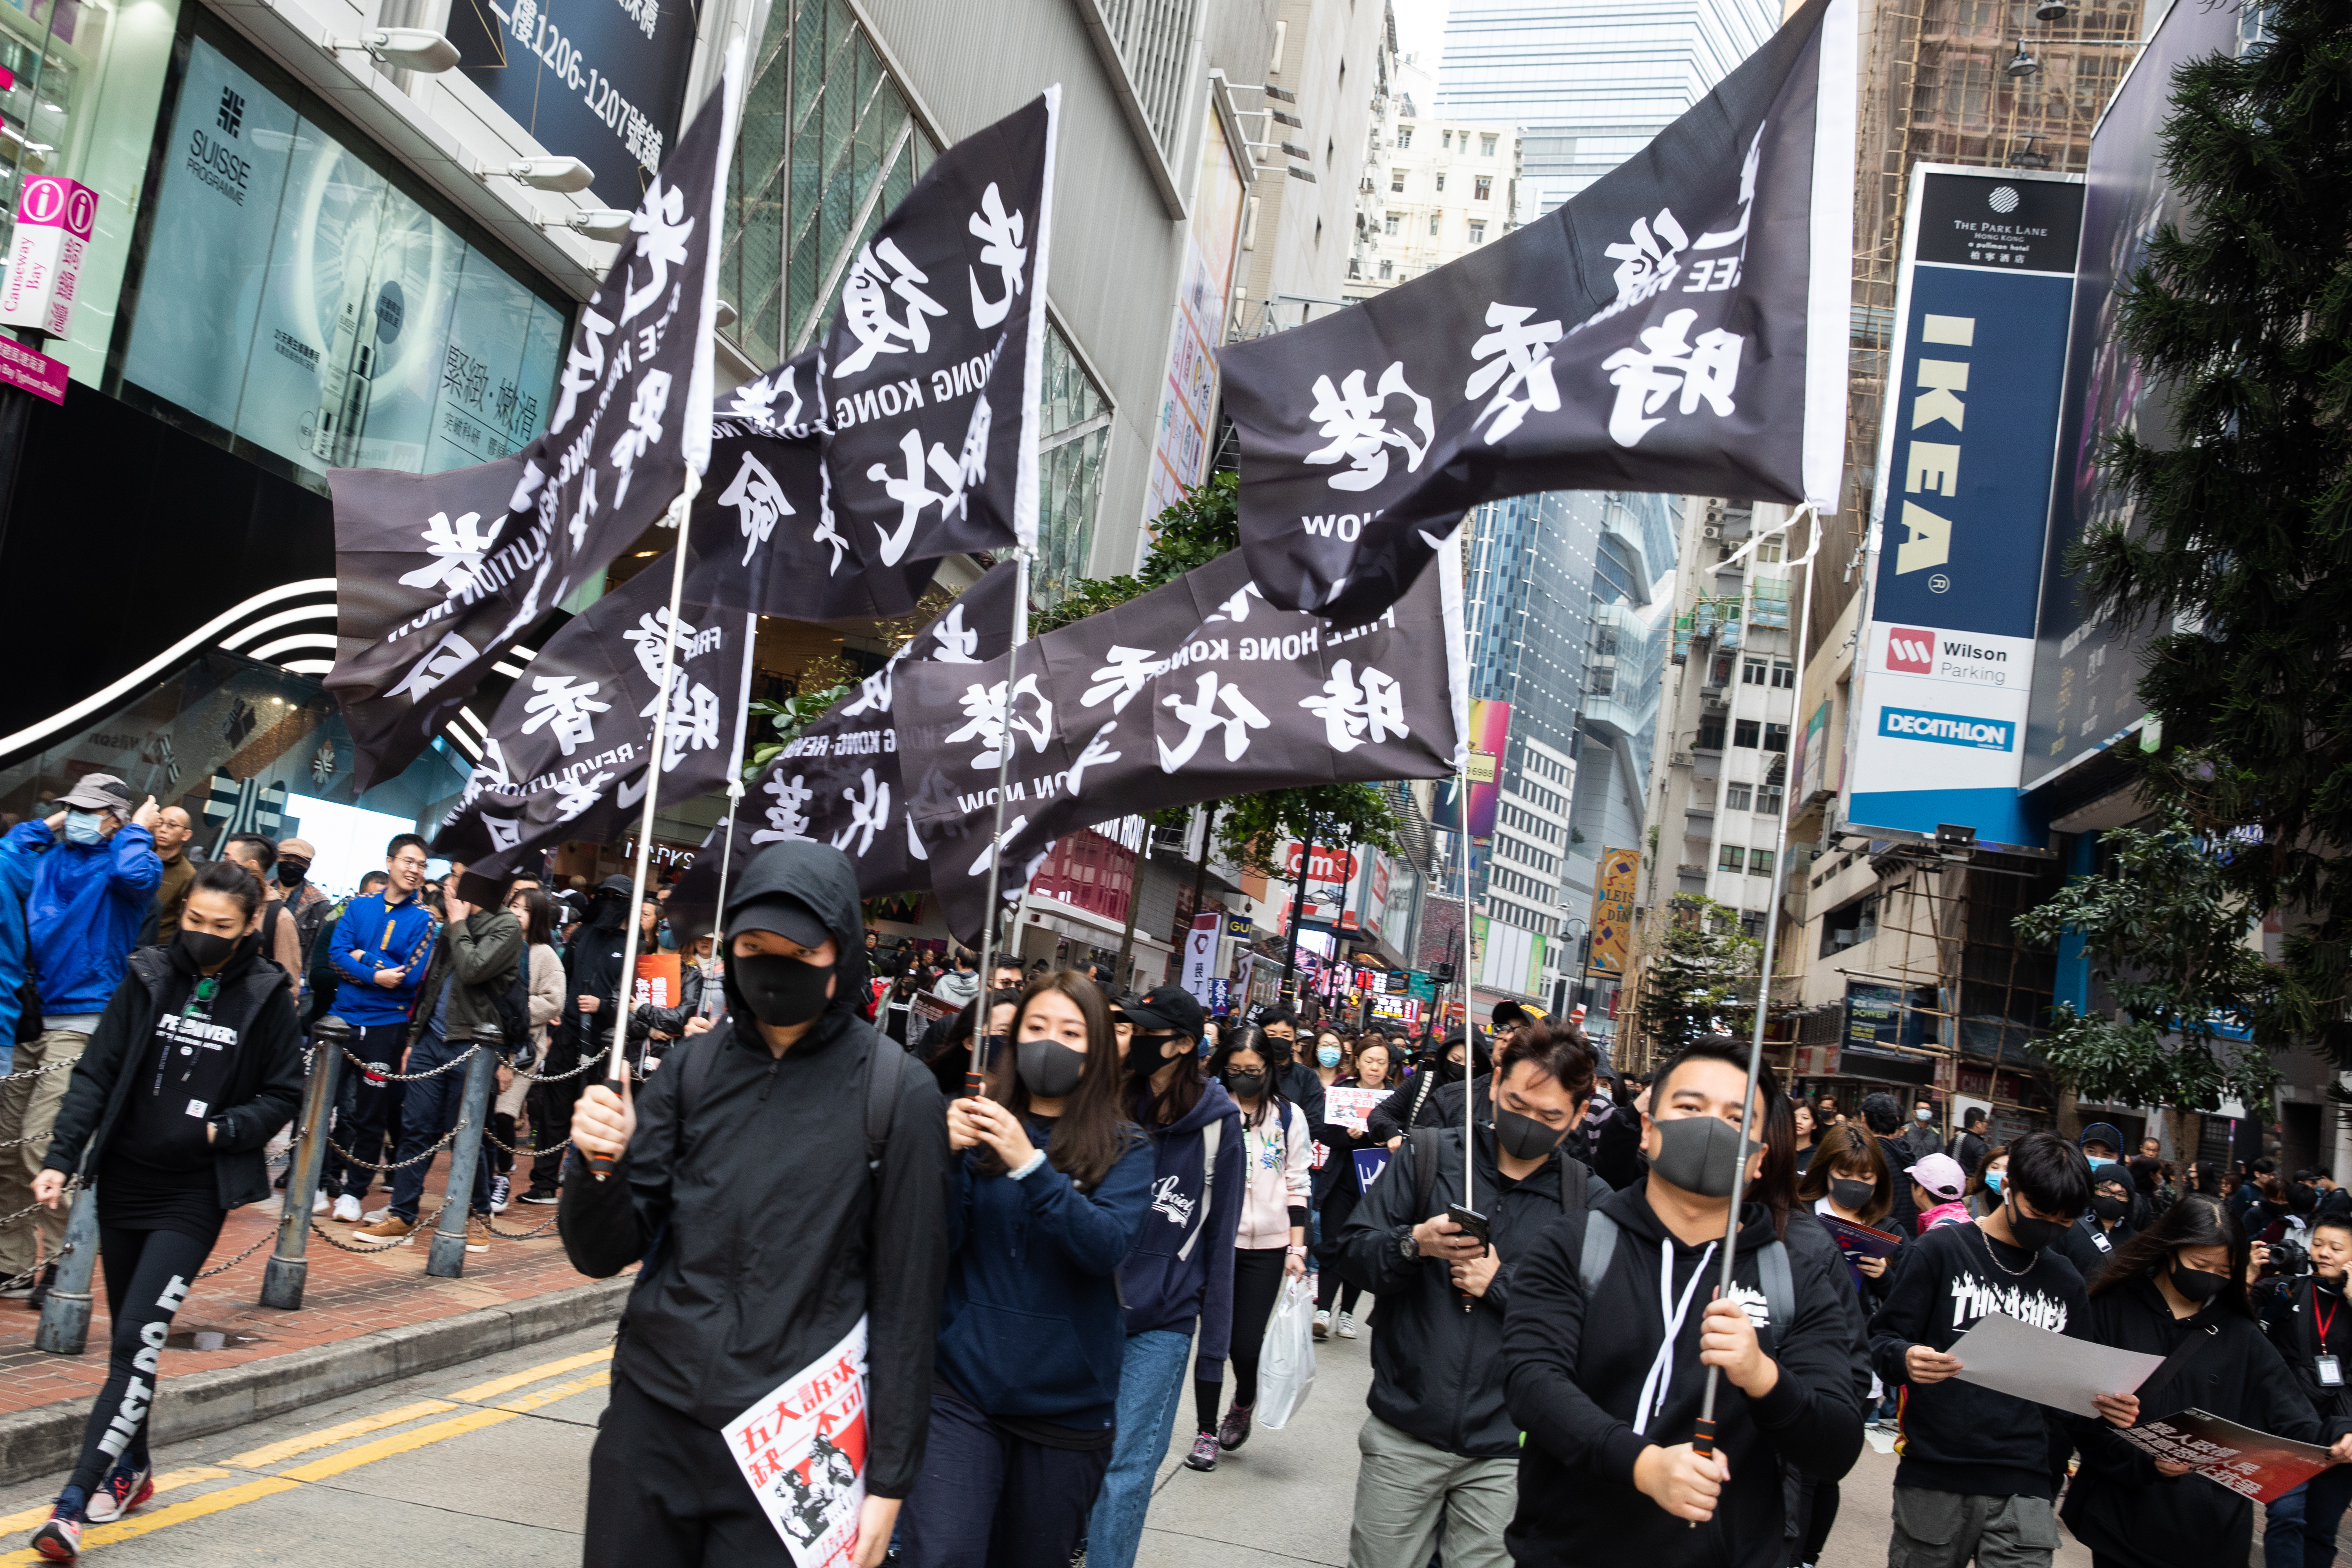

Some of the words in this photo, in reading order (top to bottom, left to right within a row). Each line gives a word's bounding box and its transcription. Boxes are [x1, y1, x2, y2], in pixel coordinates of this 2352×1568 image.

[190, 129, 251, 190] SUISSE
[186, 158, 244, 207] PROGRAMME
[1954, 220, 1977, 230] THE
[1981, 222, 2012, 234] PARK
[2015, 225, 2048, 237] LANE
[1974, 232, 1999, 241] HONG
[2000, 235, 2025, 243] KONG
[4, 237, 35, 312] Causeway
[26, 263, 48, 289] Bay
[1896, 313, 1975, 576] IKEA
[1944, 641, 2008, 662] Wilson
[1941, 662, 2006, 686] Parking
[1887, 713, 2007, 746] DECATHLON
[1120, 814, 1156, 860] HOUE
[1229, 921, 1250, 933] GU
[1852, 1009, 1888, 1019] POWER
[1331, 1089, 1376, 1099] 五大訴求
[132, 1322, 169, 1374] DO
[155, 1275, 189, 1312] IT
[736, 1355, 857, 1460] 五大訴求
[748, 1380, 863, 1489] 缺一不可
[2145, 1421, 2243, 1458] 殺人政權
